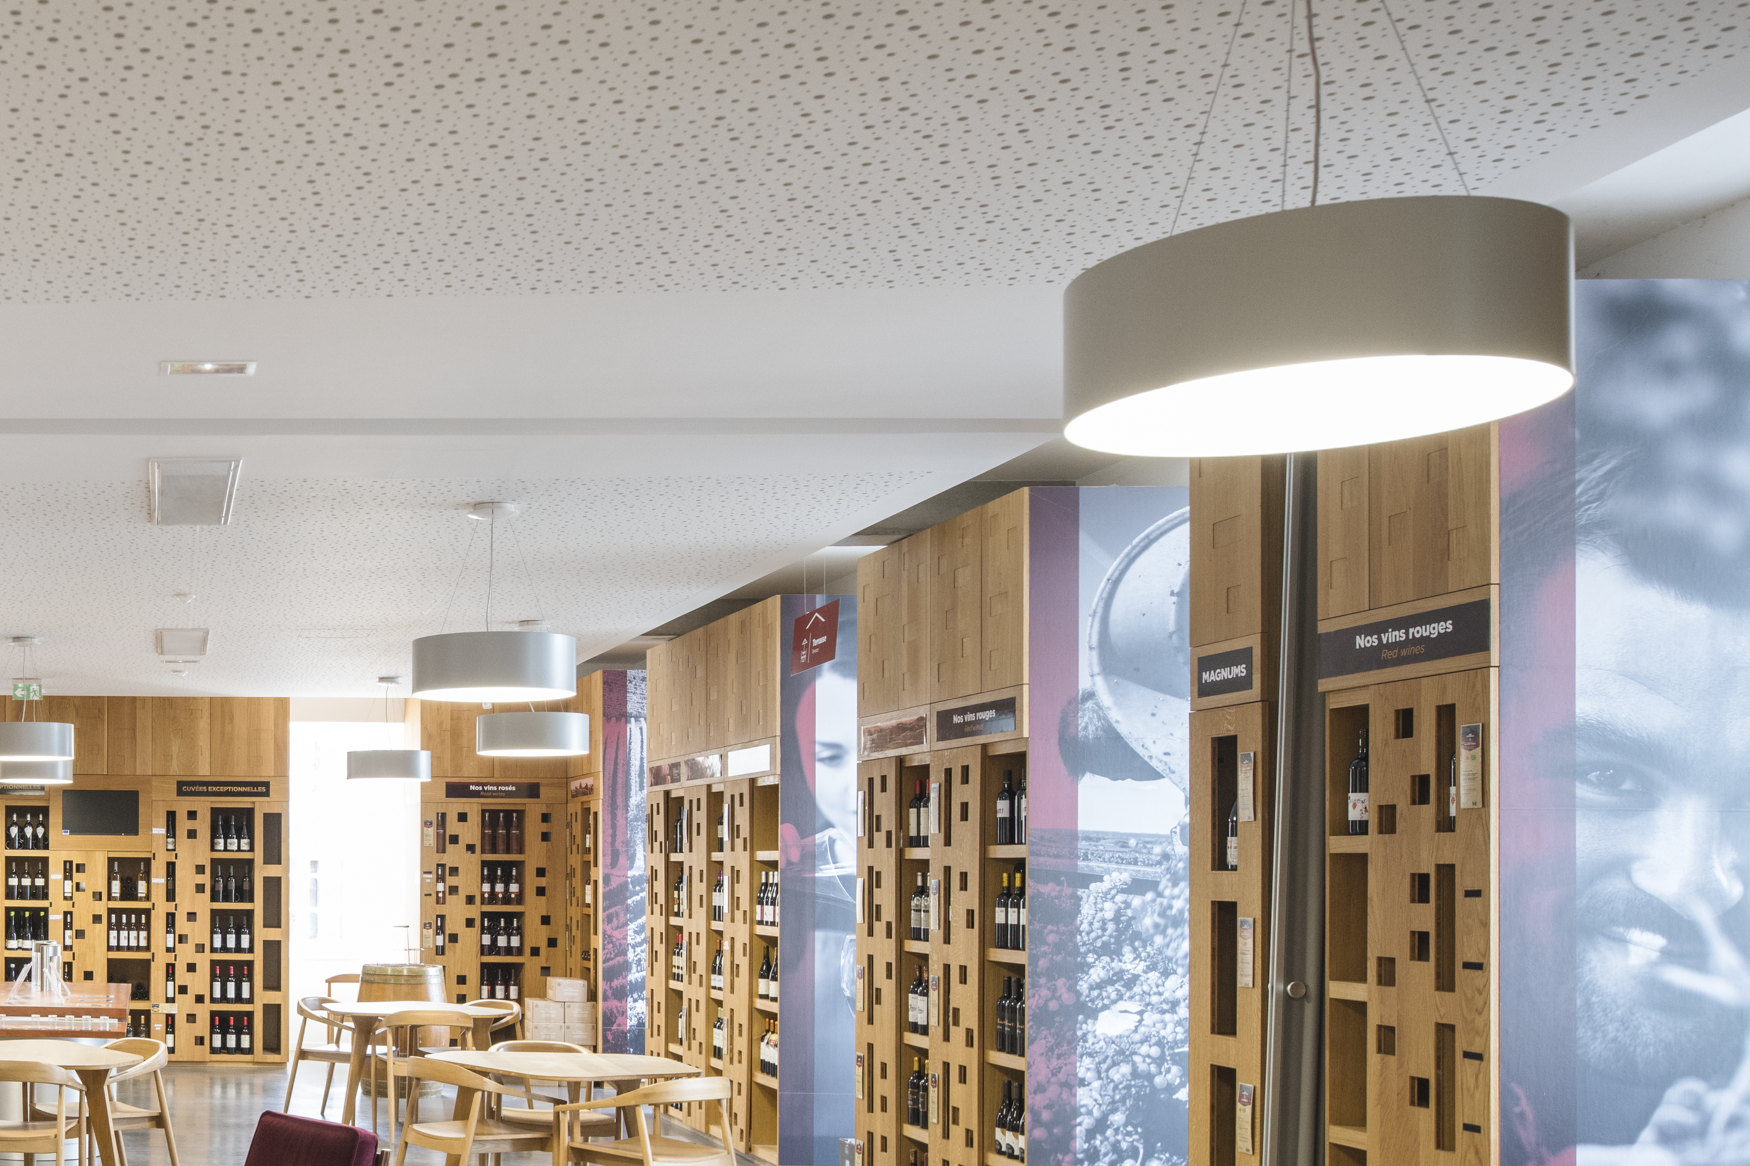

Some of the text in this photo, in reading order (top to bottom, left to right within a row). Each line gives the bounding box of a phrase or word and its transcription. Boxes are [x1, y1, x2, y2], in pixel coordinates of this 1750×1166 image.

[1355, 619, 1454, 650] Nos vins rouges
[1381, 644, 1426, 660] Red wines
[1202, 664, 1247, 684] MAGNUMS
[952, 708, 996, 725] Nos vins rouges
